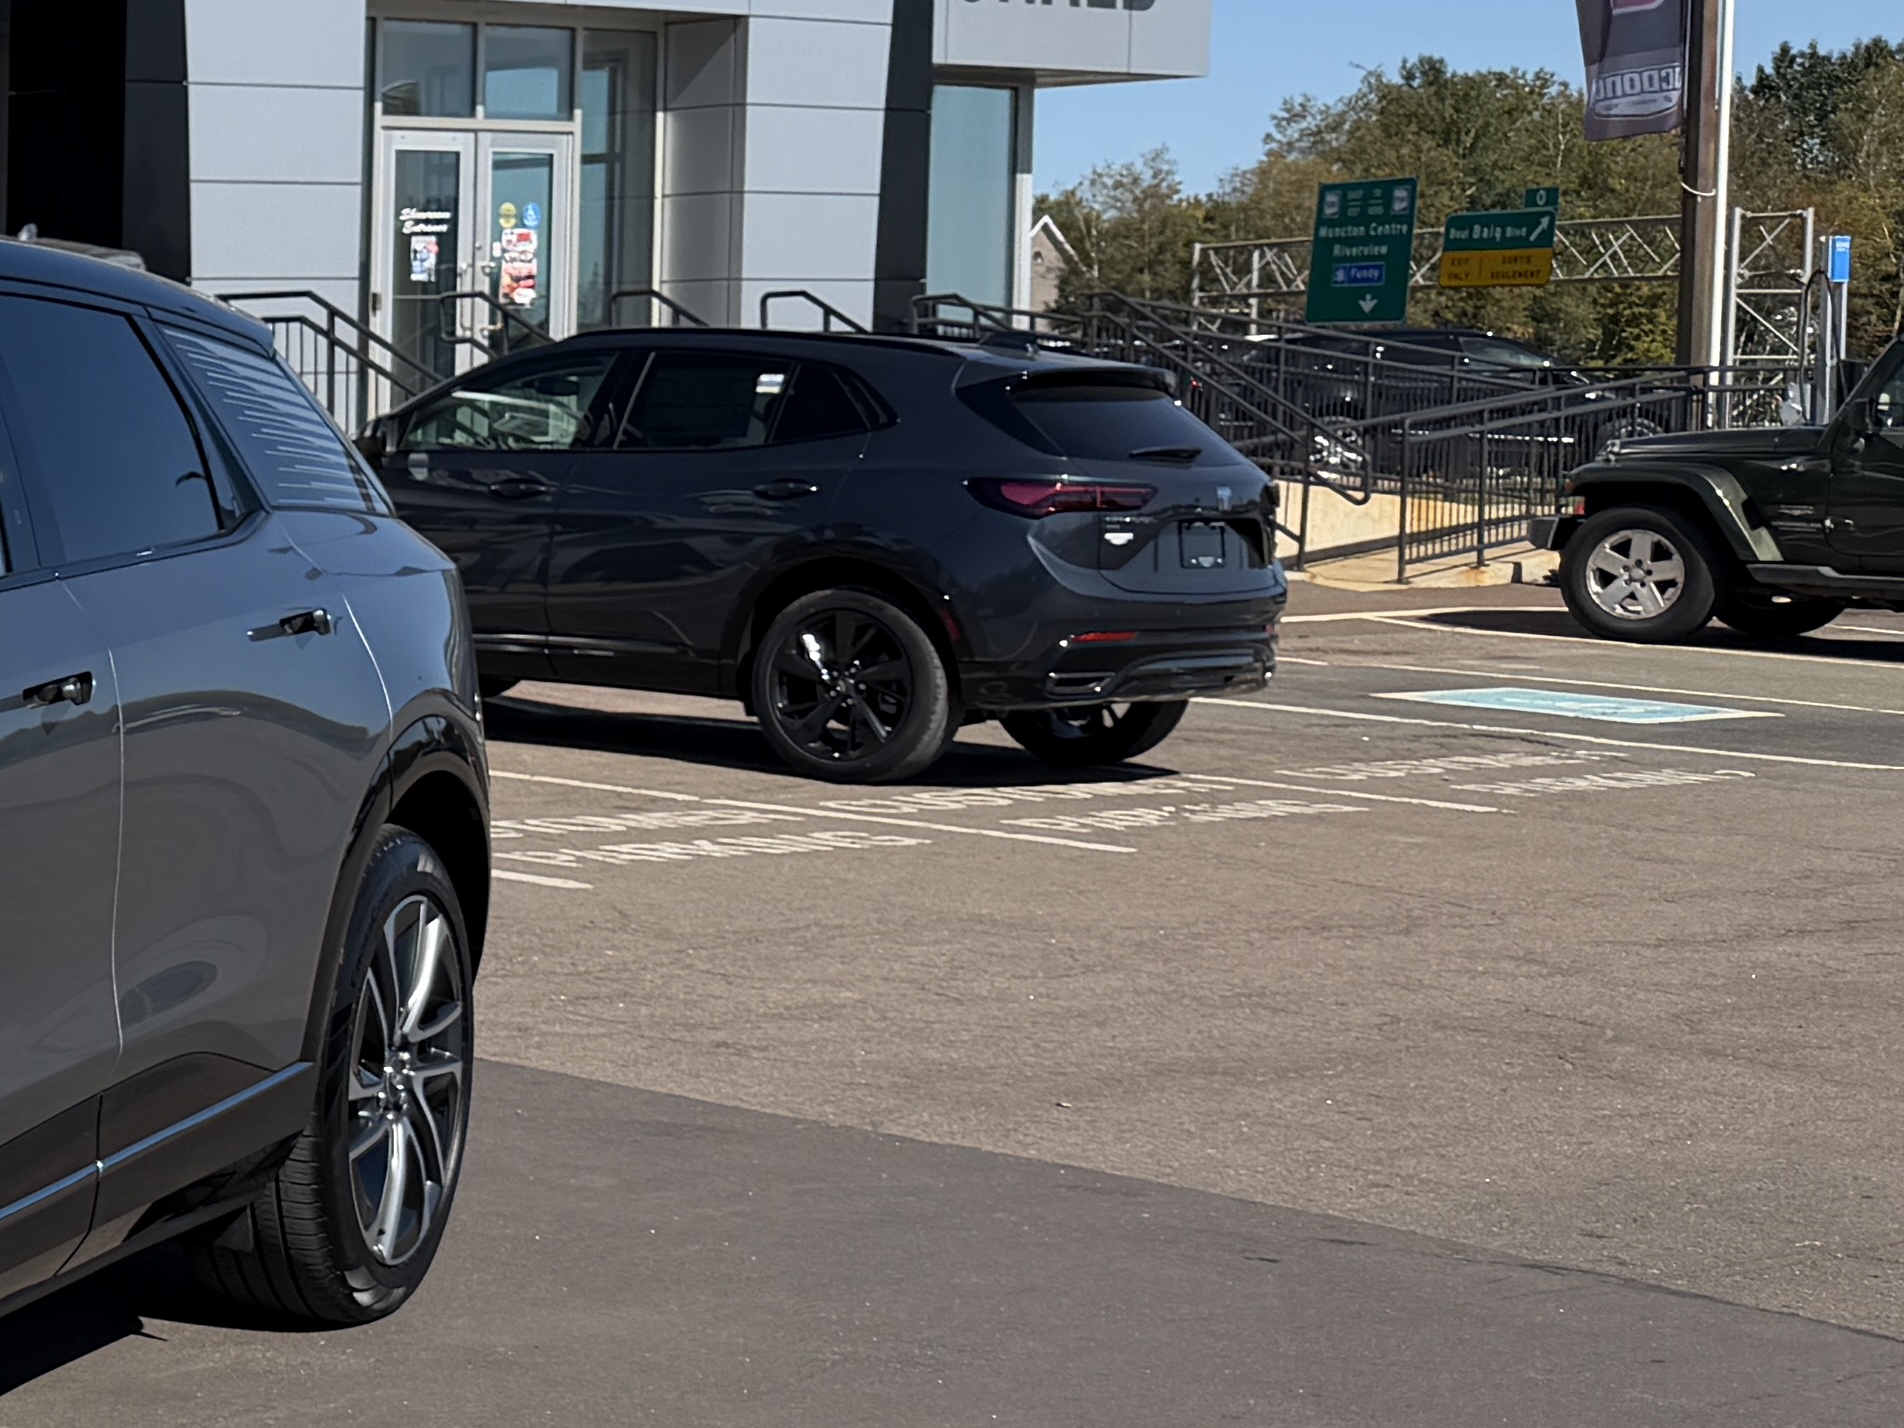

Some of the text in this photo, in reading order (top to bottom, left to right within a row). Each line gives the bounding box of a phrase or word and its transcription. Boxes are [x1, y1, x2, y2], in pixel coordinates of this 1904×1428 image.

[1369, 222, 1409, 236] Centre
[1332, 243, 1389, 258] Riverview
[489, 831, 933, 868] PARKING
